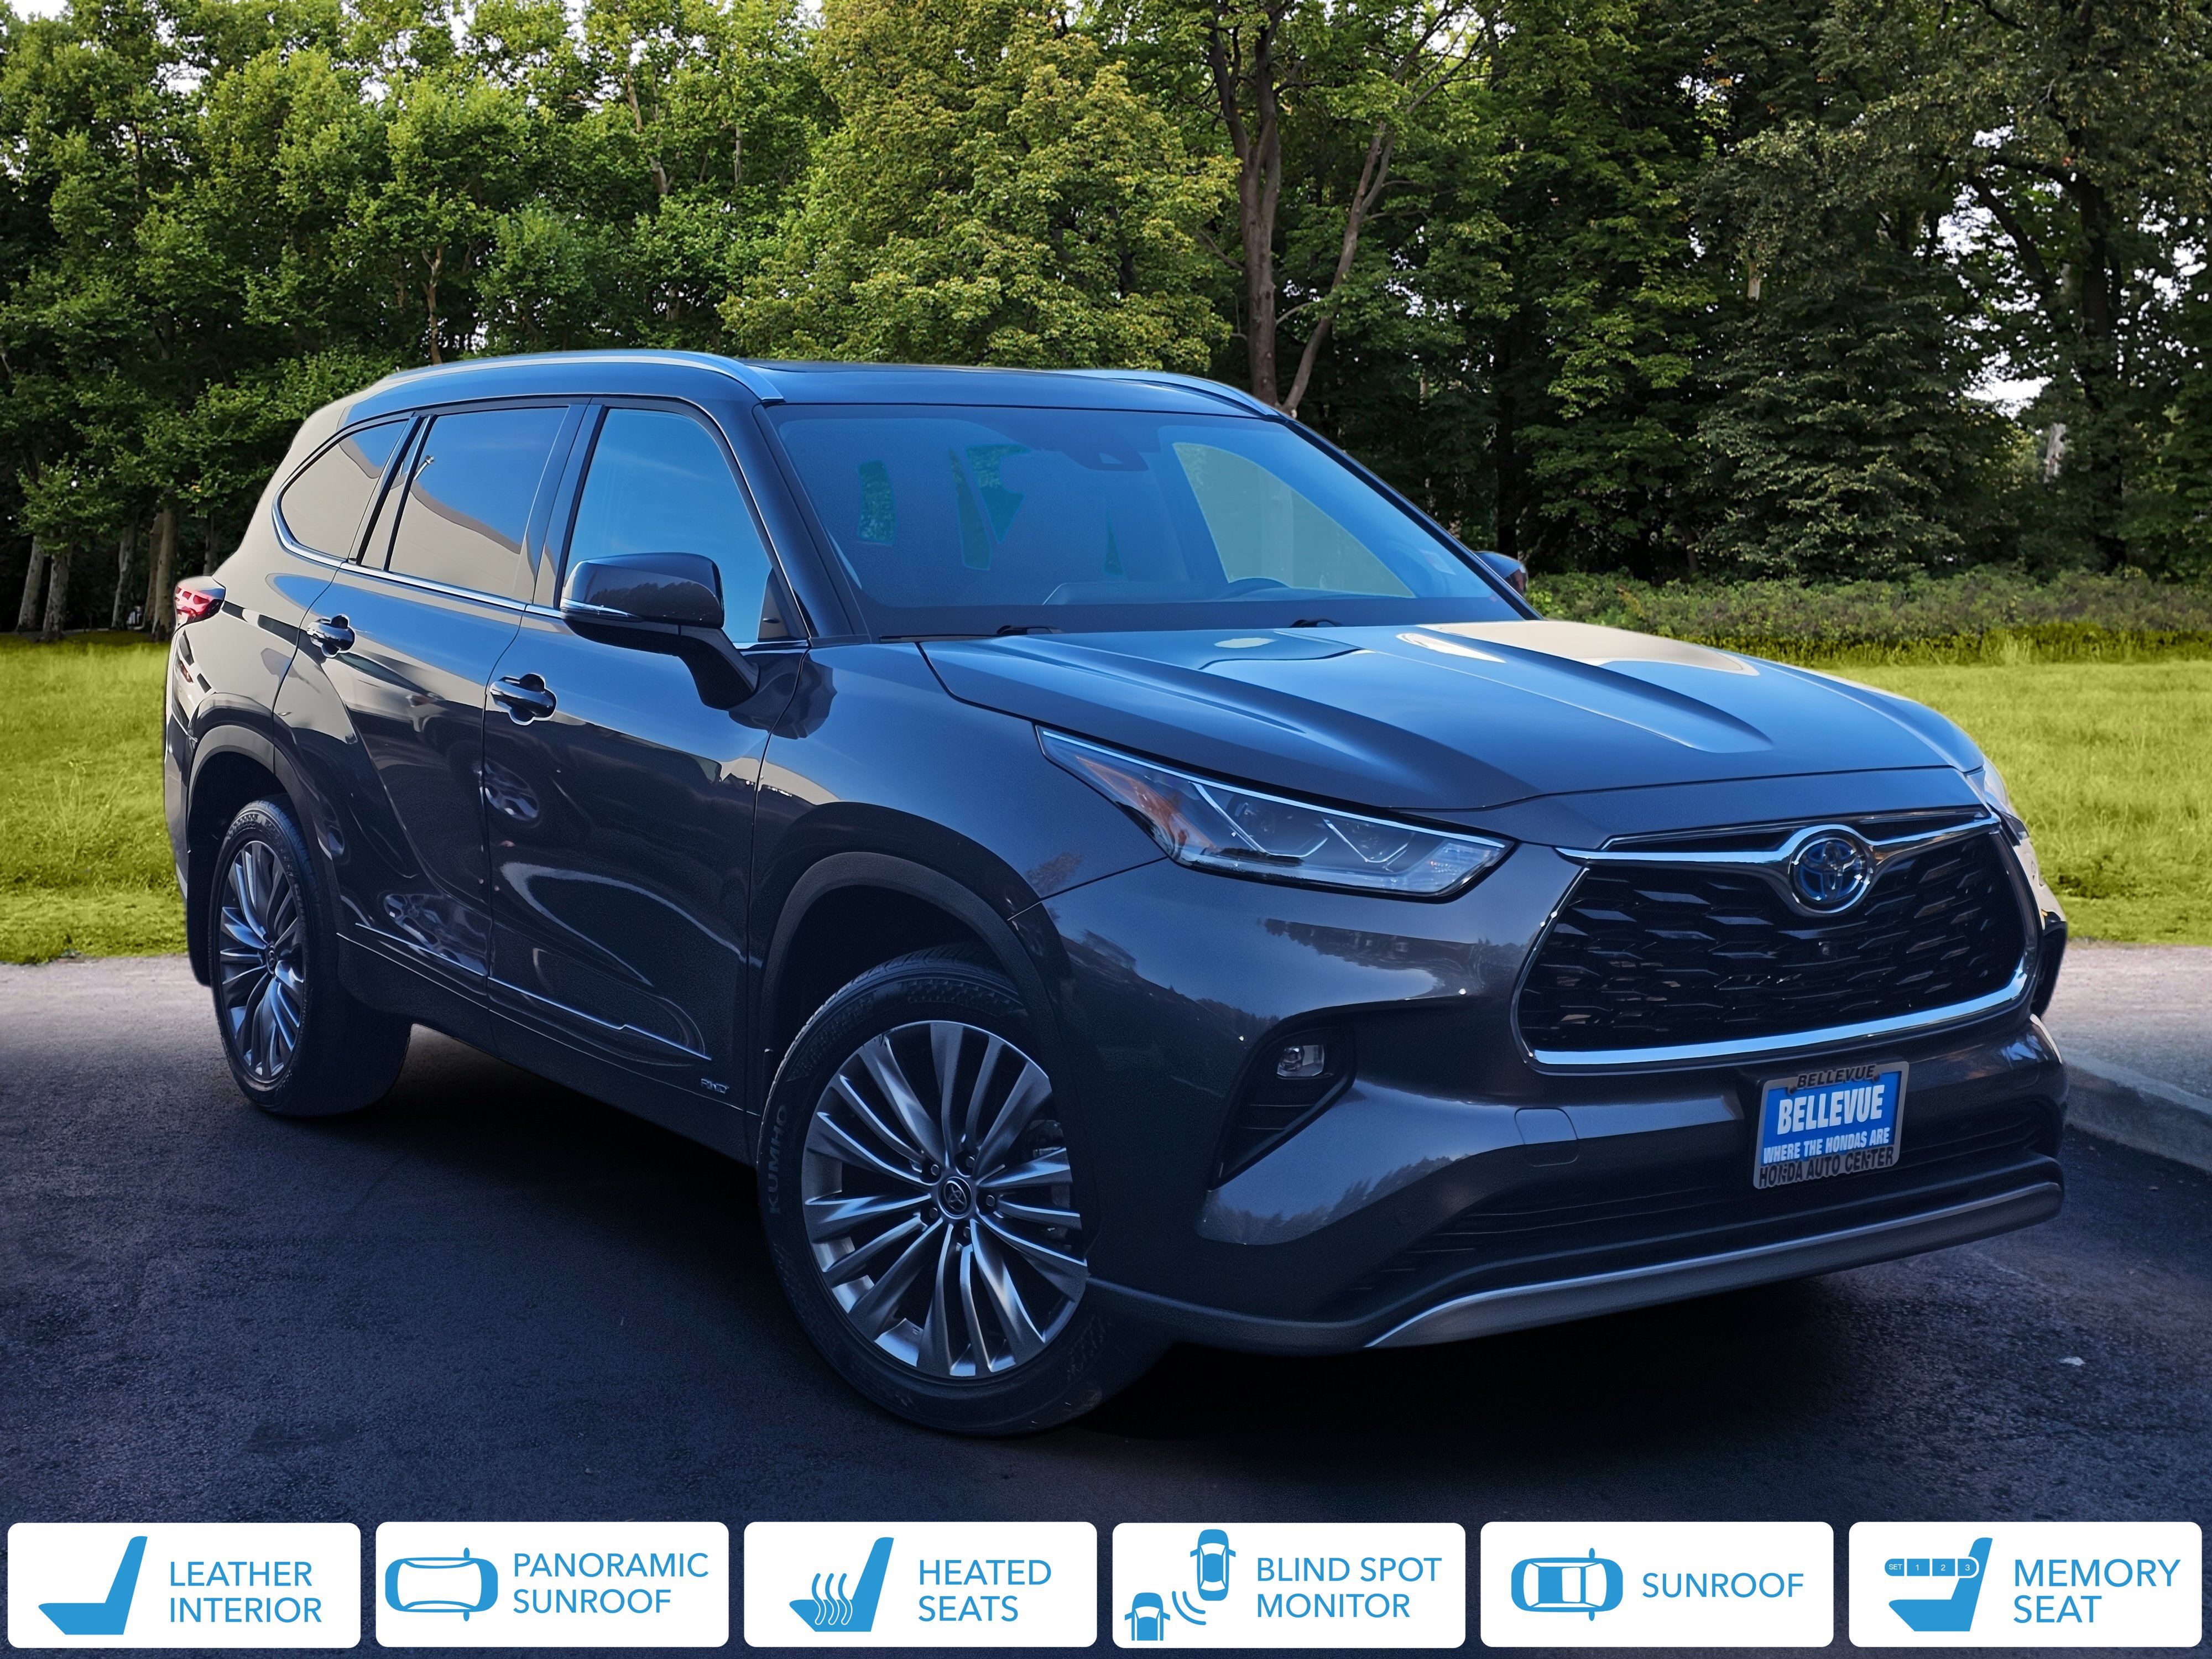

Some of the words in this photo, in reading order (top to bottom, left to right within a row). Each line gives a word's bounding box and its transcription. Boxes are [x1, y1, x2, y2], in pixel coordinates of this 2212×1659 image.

[1797, 1065, 1876, 1088] BELLEVUE
[1777, 1084, 1885, 1135] BELLEVUE
[768, 1105, 787, 1213] KUMHO
[1764, 1142, 1801, 1164] WHERE
[1803, 1138, 1823, 1157] THE
[1825, 1131, 1867, 1153] HONDAS
[1869, 1127, 1891, 1146] ARE
[1759, 1160, 1803, 1187] HONDA
[1806, 1155, 1841, 1178] AUTO
[1845, 1146, 1894, 1172] CENTER
